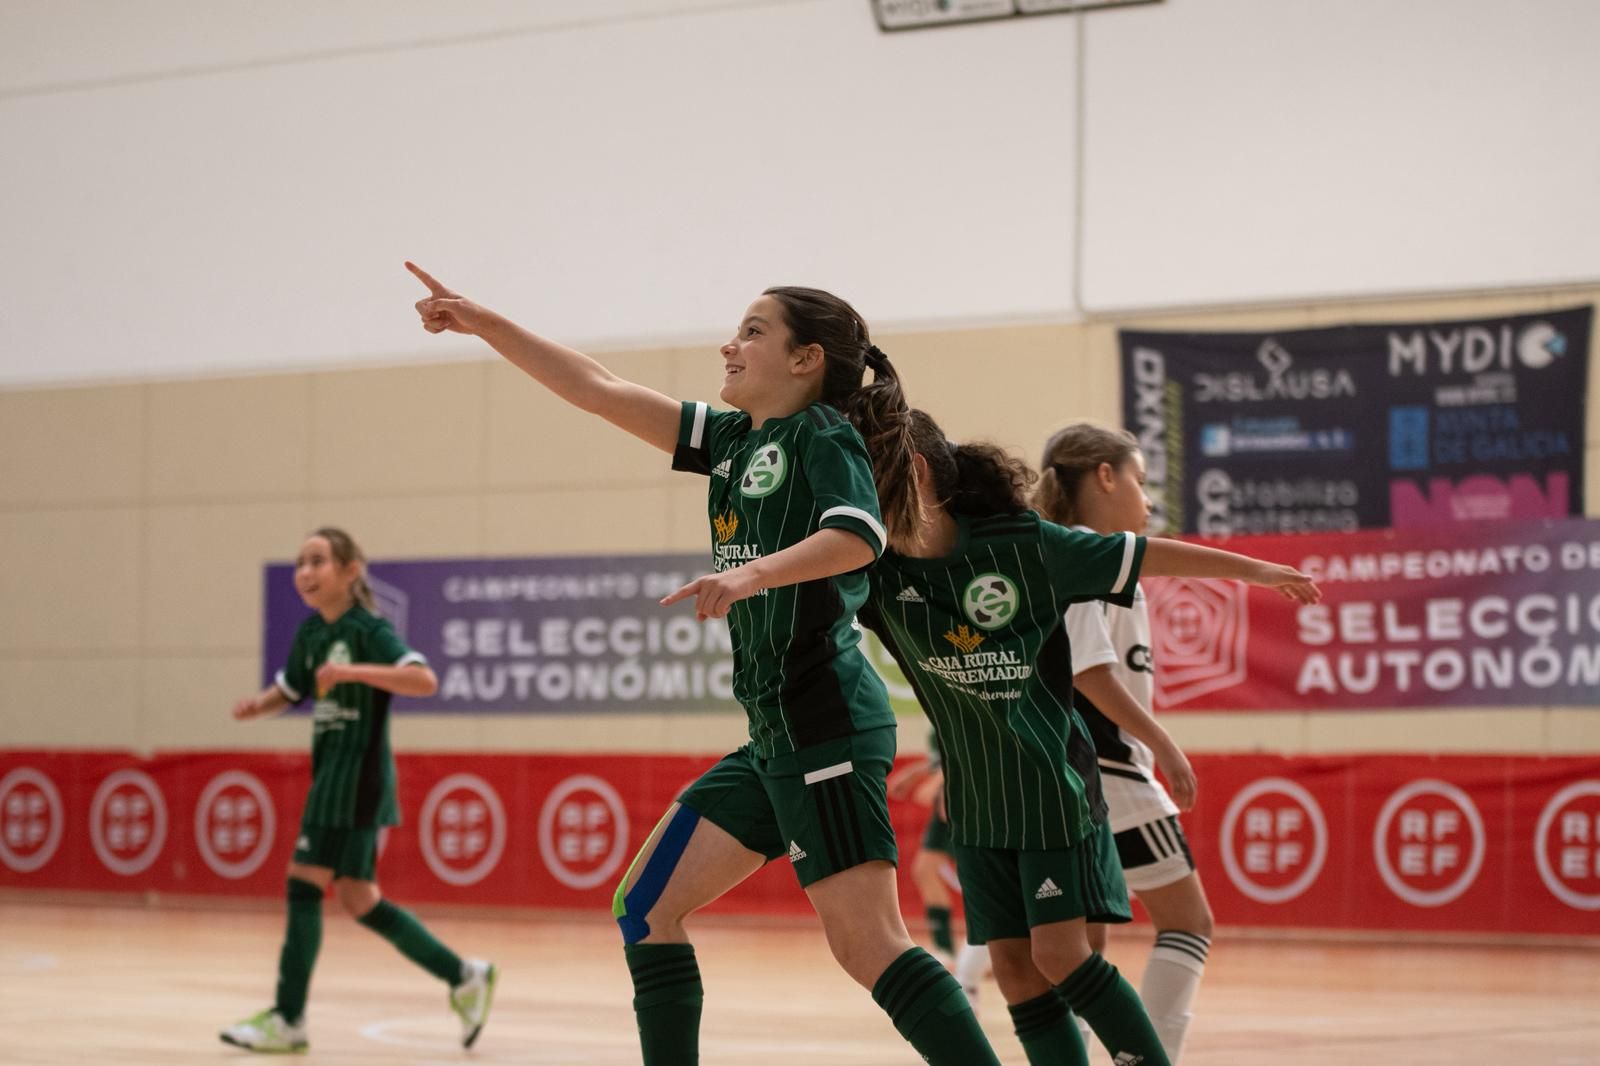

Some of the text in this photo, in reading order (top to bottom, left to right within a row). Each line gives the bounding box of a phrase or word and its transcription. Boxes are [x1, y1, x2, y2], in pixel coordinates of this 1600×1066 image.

[1302, 543, 1551, 583] CAMPEONATO
[443, 574, 639, 602] CAMPEONATO
[929, 651, 1020, 671] CAJA RURAL
[213, 796, 256, 821] RF
[439, 800, 486, 827] RF
[558, 801, 608, 829] RF
[1244, 808, 1302, 838] RF
[1400, 810, 1459, 841] RF
[1562, 811, 1600, 843] R
[213, 825, 255, 853] EF
[439, 831, 485, 859] EF
[558, 832, 607, 862] EF
[1244, 842, 1302, 873] EF
[1400, 844, 1458, 875] EF
[1035, 888, 1063, 900] adidas
